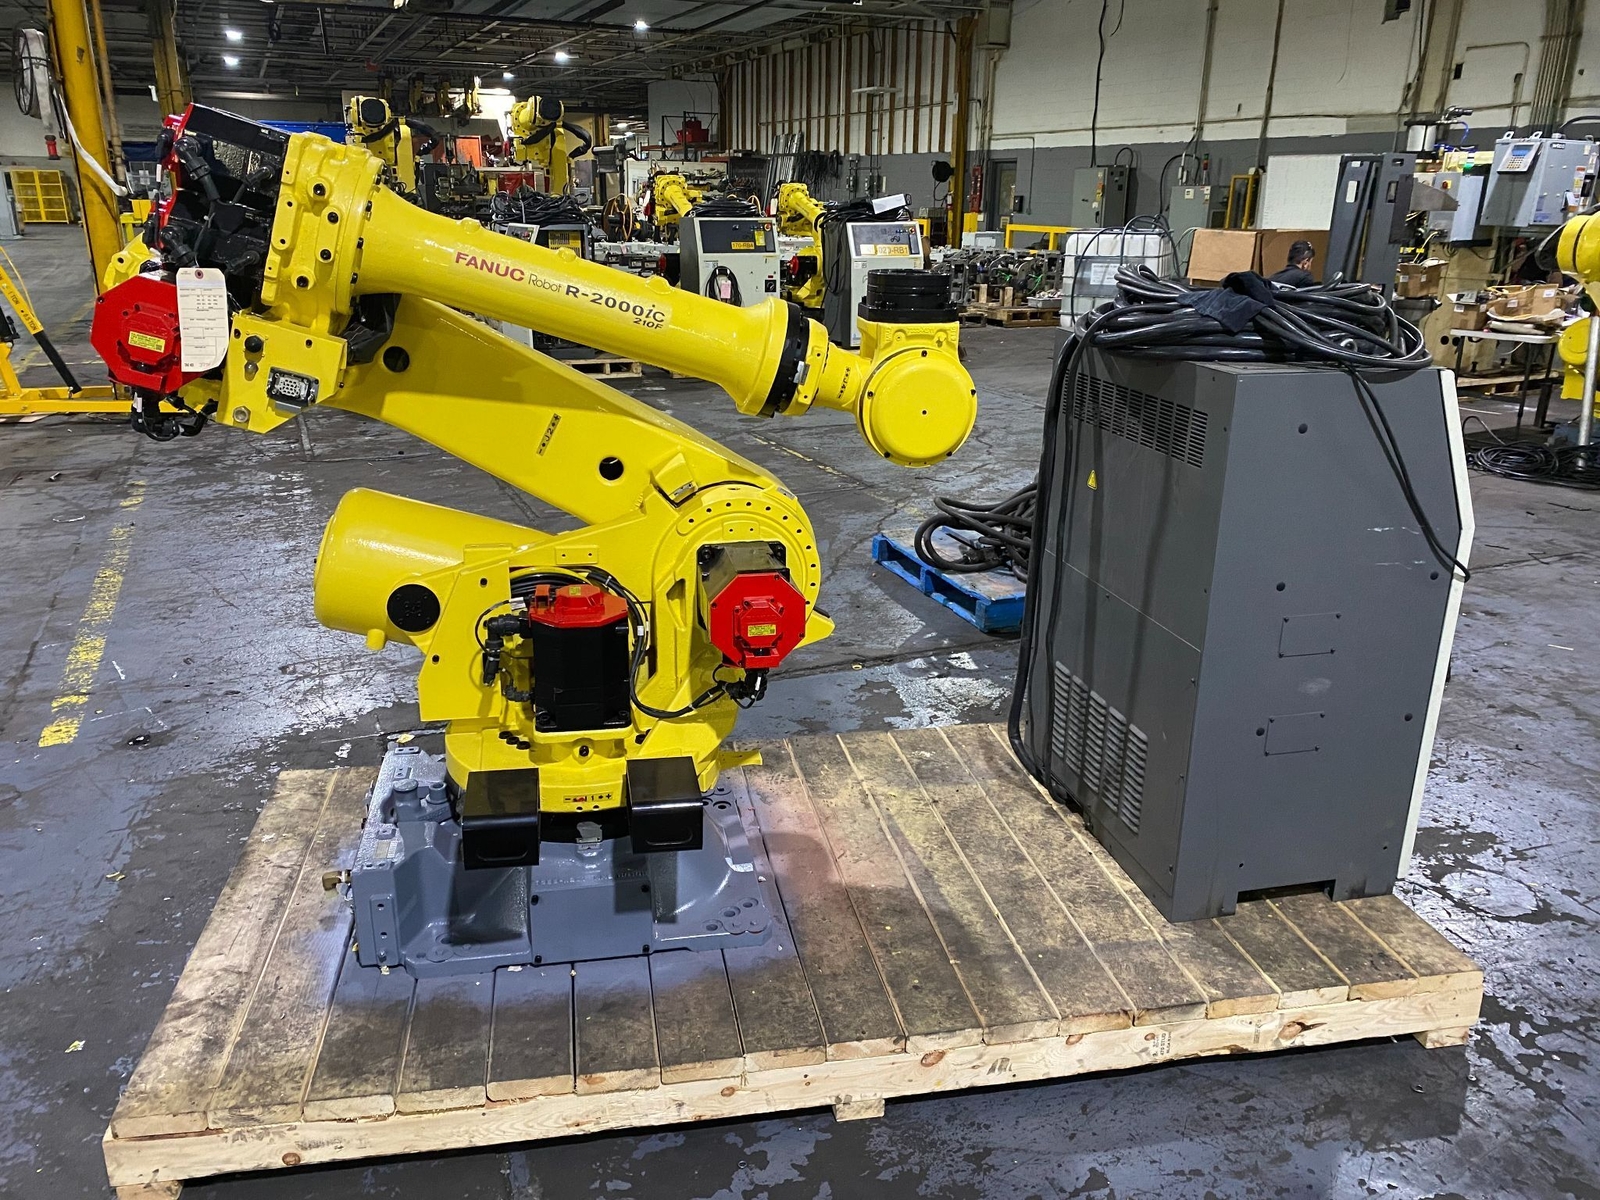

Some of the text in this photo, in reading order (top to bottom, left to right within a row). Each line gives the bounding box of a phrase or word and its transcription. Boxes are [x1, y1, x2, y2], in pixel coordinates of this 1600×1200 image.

[455, 251, 525, 282] FANUC
[528, 273, 562, 293] Robot
[10, 294, 21, 306] TON
[28, 320, 38, 331] TON
[633, 317, 664, 330] 210F
